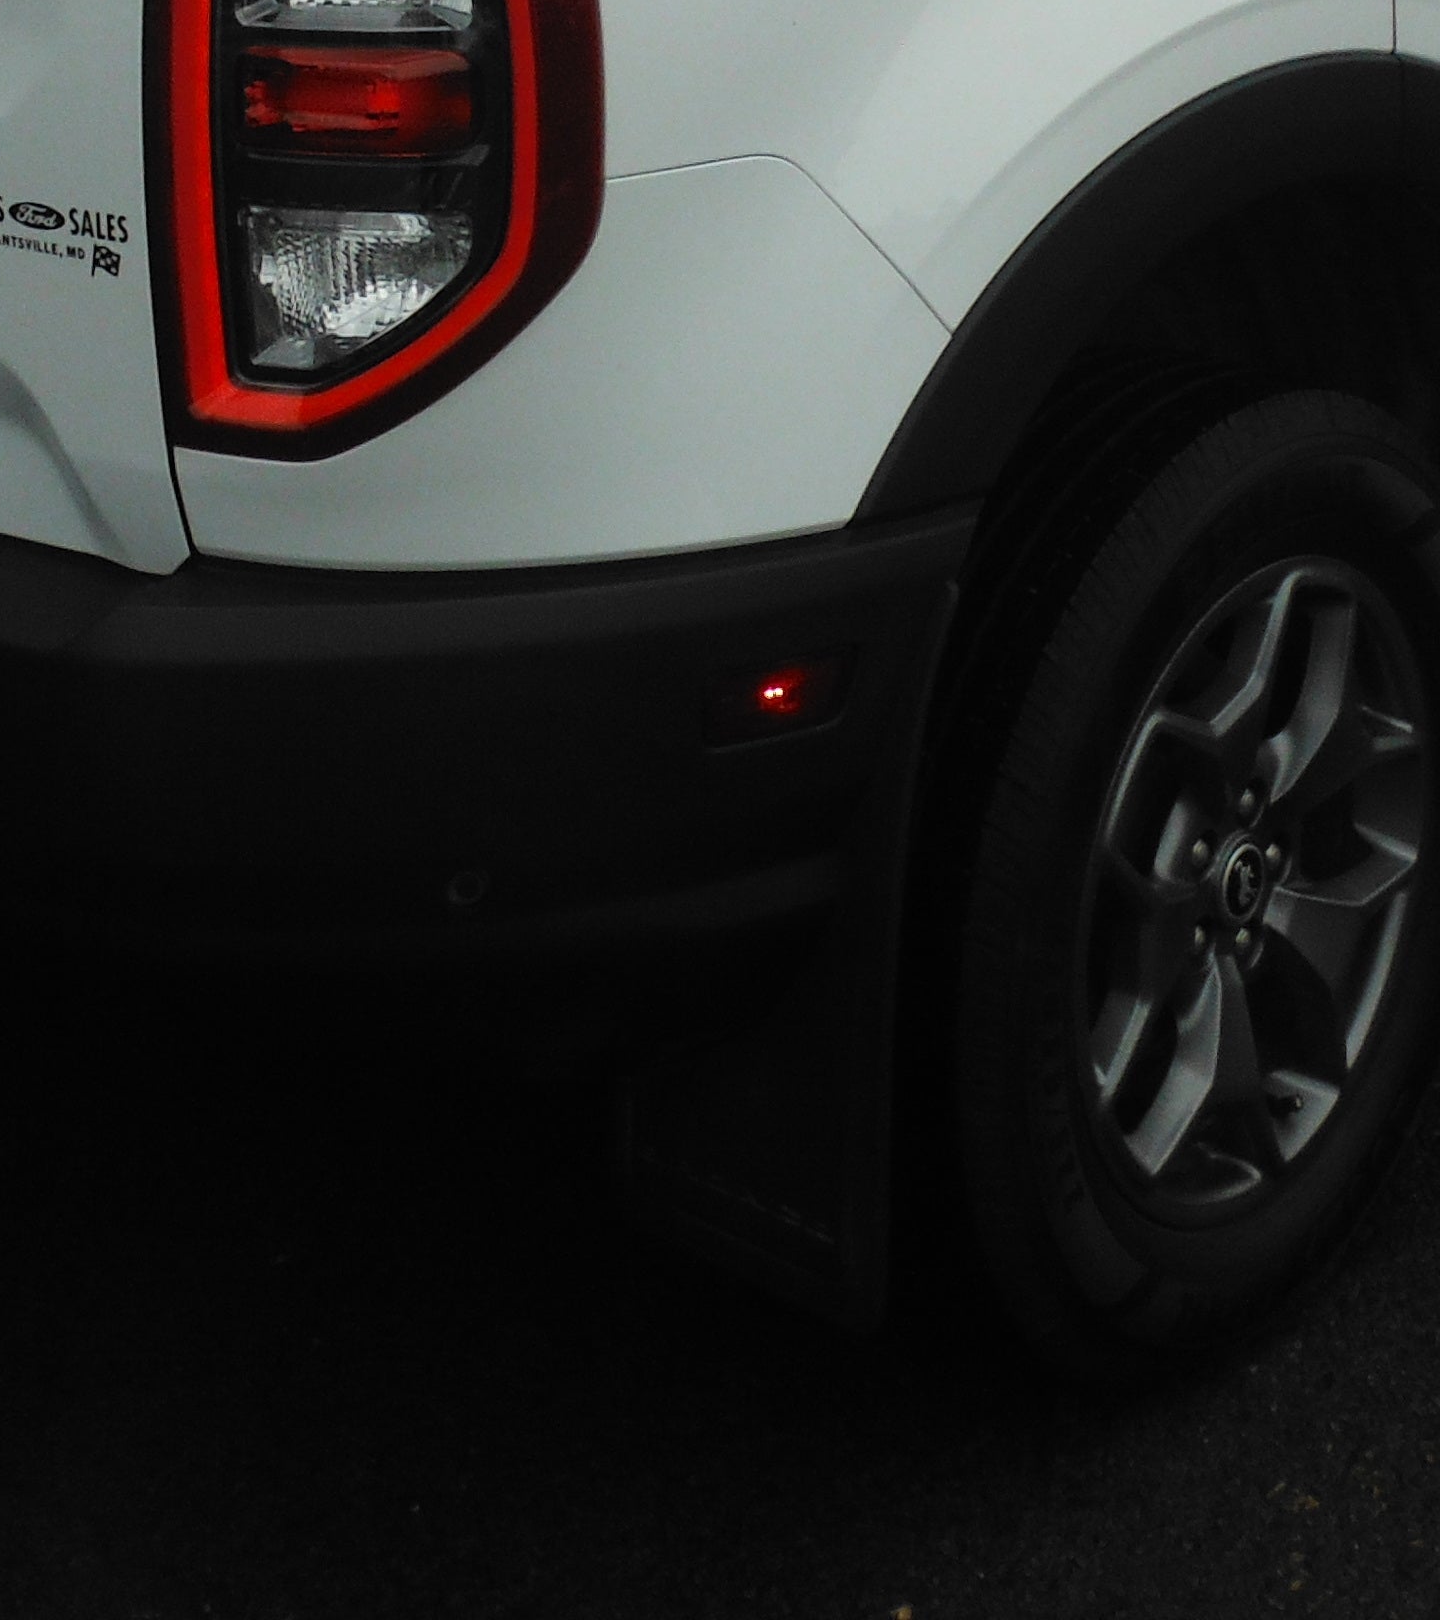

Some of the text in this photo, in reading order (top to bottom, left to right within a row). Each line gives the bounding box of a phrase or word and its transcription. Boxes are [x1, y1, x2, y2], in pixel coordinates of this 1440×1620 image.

[15, 203, 59, 227] Ford
[69, 207, 128, 243] SALES
[66, 245, 85, 260] MD
